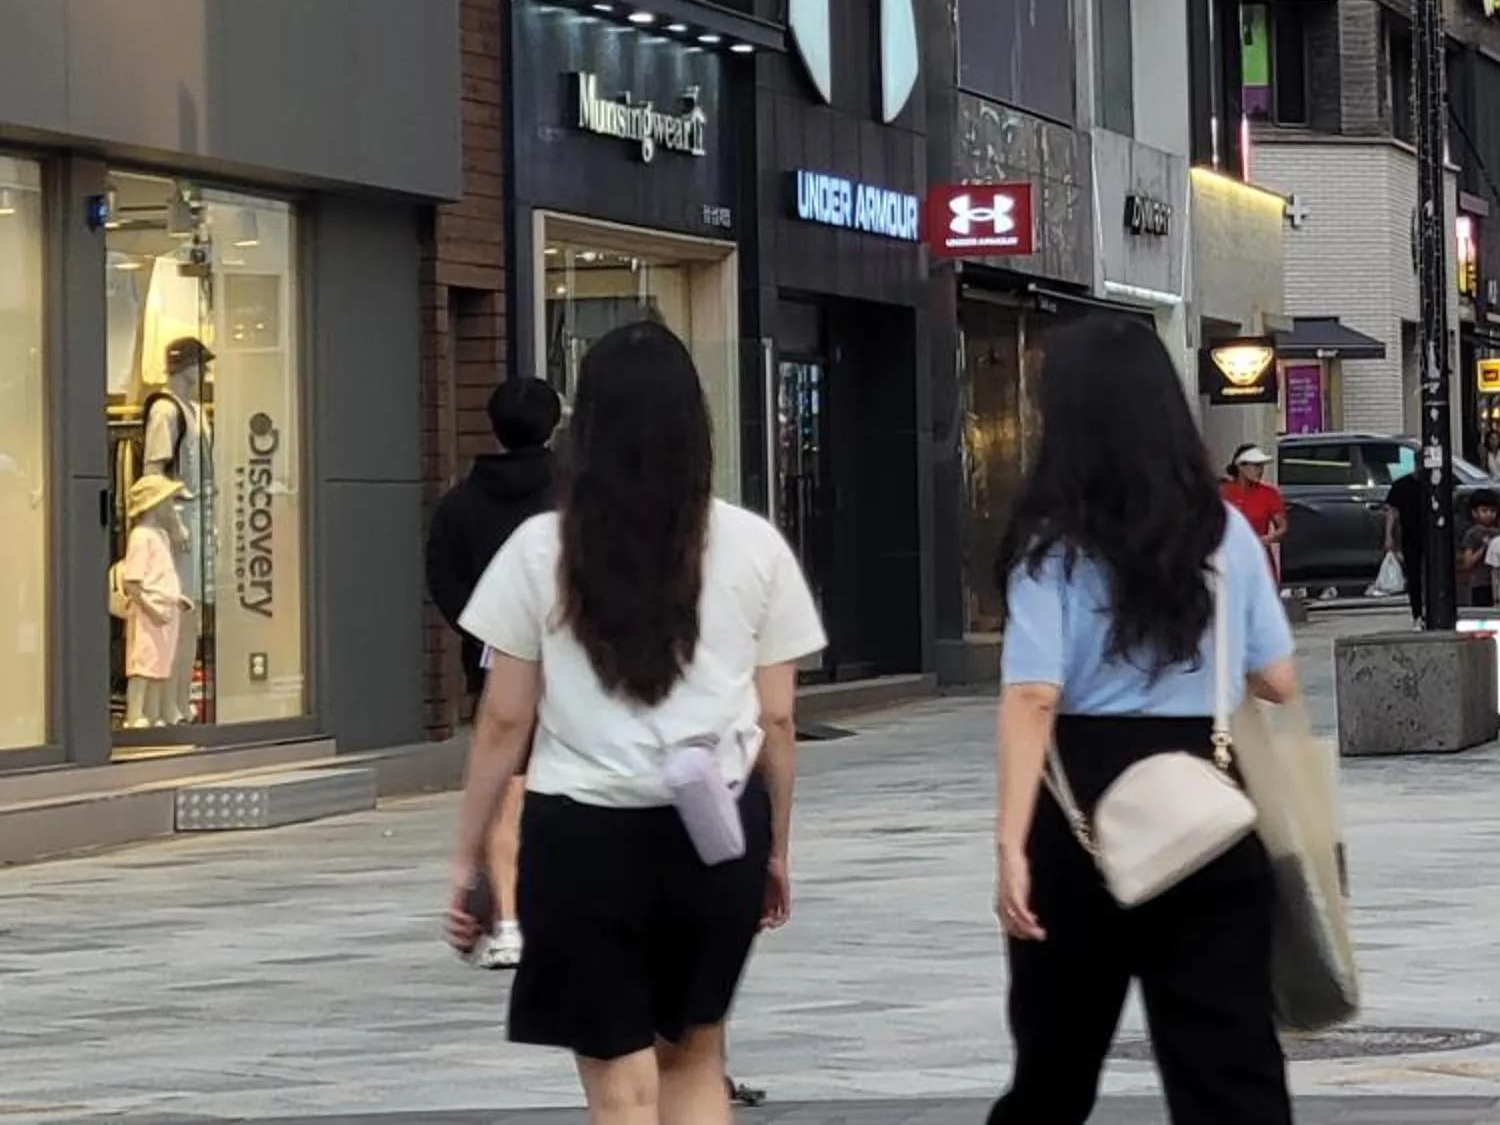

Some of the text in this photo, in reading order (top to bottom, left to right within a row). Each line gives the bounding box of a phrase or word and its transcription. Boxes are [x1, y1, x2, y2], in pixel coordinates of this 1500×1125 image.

[579, 71, 693, 163] Munsingwear
[797, 170, 918, 241] UNDER ARMOUR
[240, 428, 281, 619] Discovery
